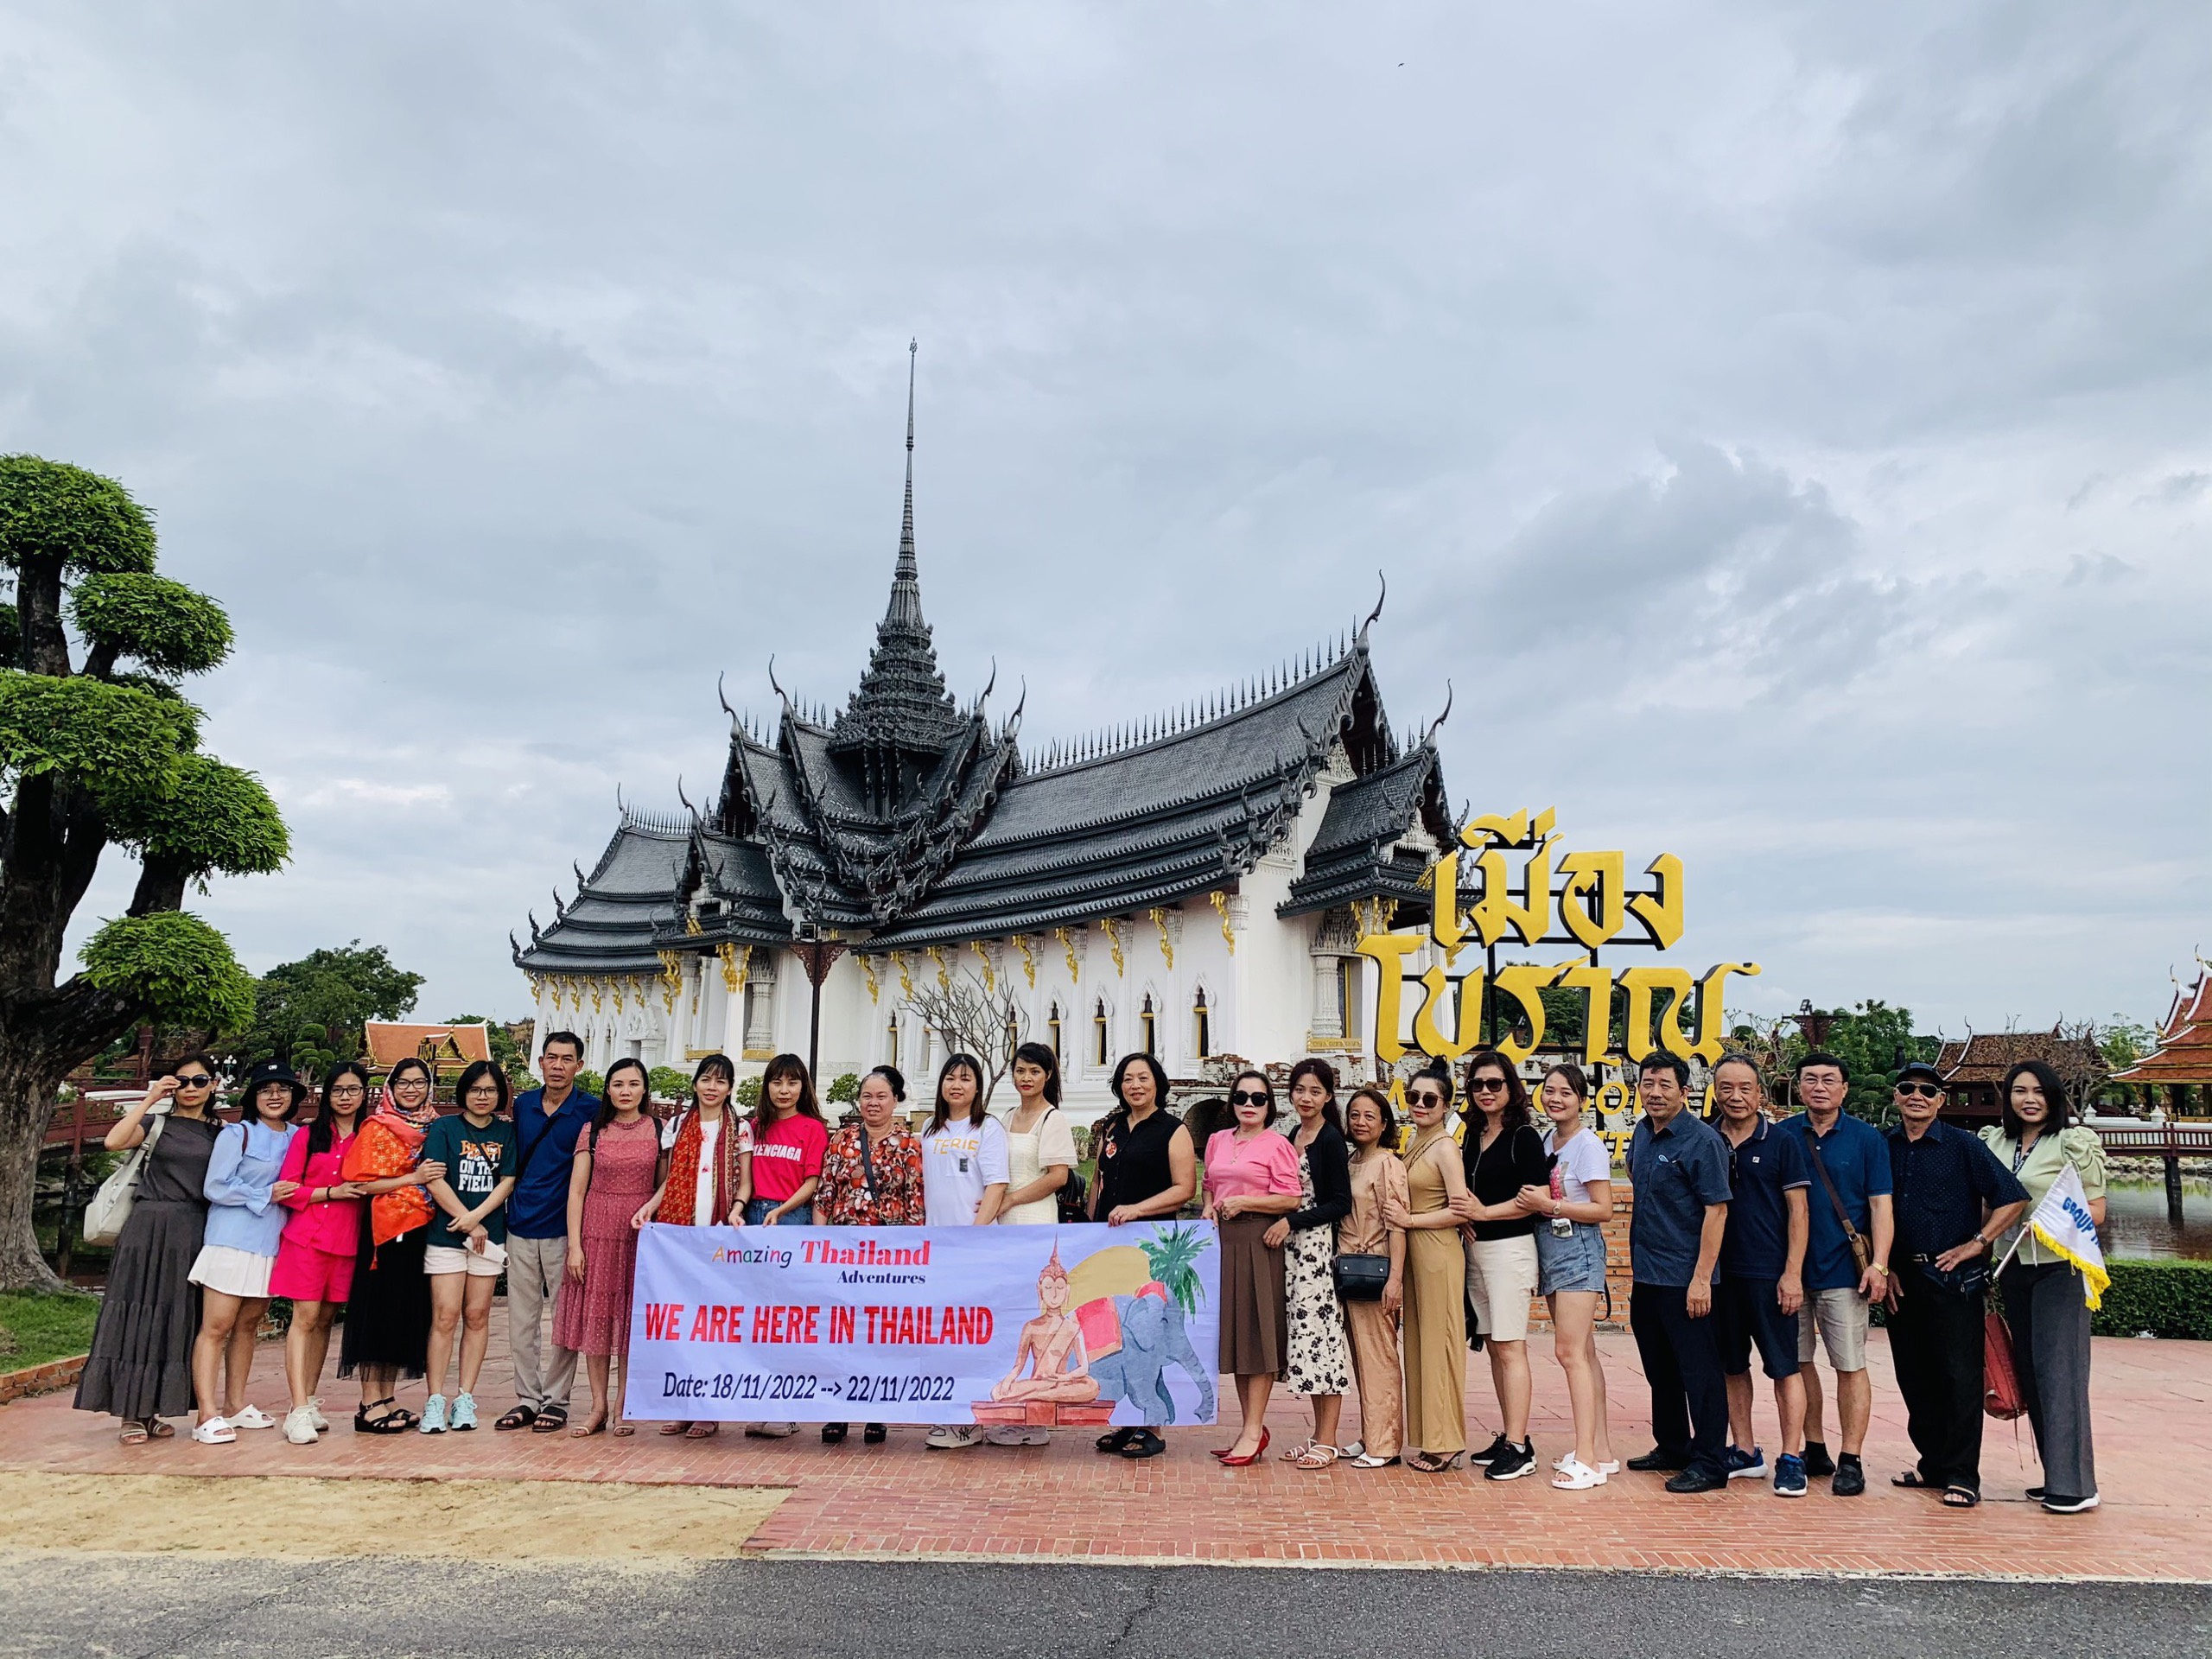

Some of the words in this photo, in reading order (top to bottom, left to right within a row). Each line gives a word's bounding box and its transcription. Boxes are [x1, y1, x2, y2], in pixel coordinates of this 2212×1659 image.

[1431, 805, 1684, 950] เมือง
[1355, 934, 1762, 1066] โบราณ
[458, 1173, 493, 1192] FIELD
[2063, 1196, 2095, 1233] GROUP
[712, 1245, 792, 1268] Amazing
[800, 1239, 931, 1266] Thailand
[836, 1270, 926, 1284] Adventures
[645, 1303, 684, 1341] WE
[690, 1305, 744, 1343] ARE
[752, 1306, 820, 1344] HERE
[829, 1306, 855, 1344] IN
[864, 1306, 993, 1344] THAILAND
[663, 1372, 709, 1398] Date:
[710, 1373, 817, 1401] 18/11/2022
[846, 1375, 955, 1403] 22/11/2022
